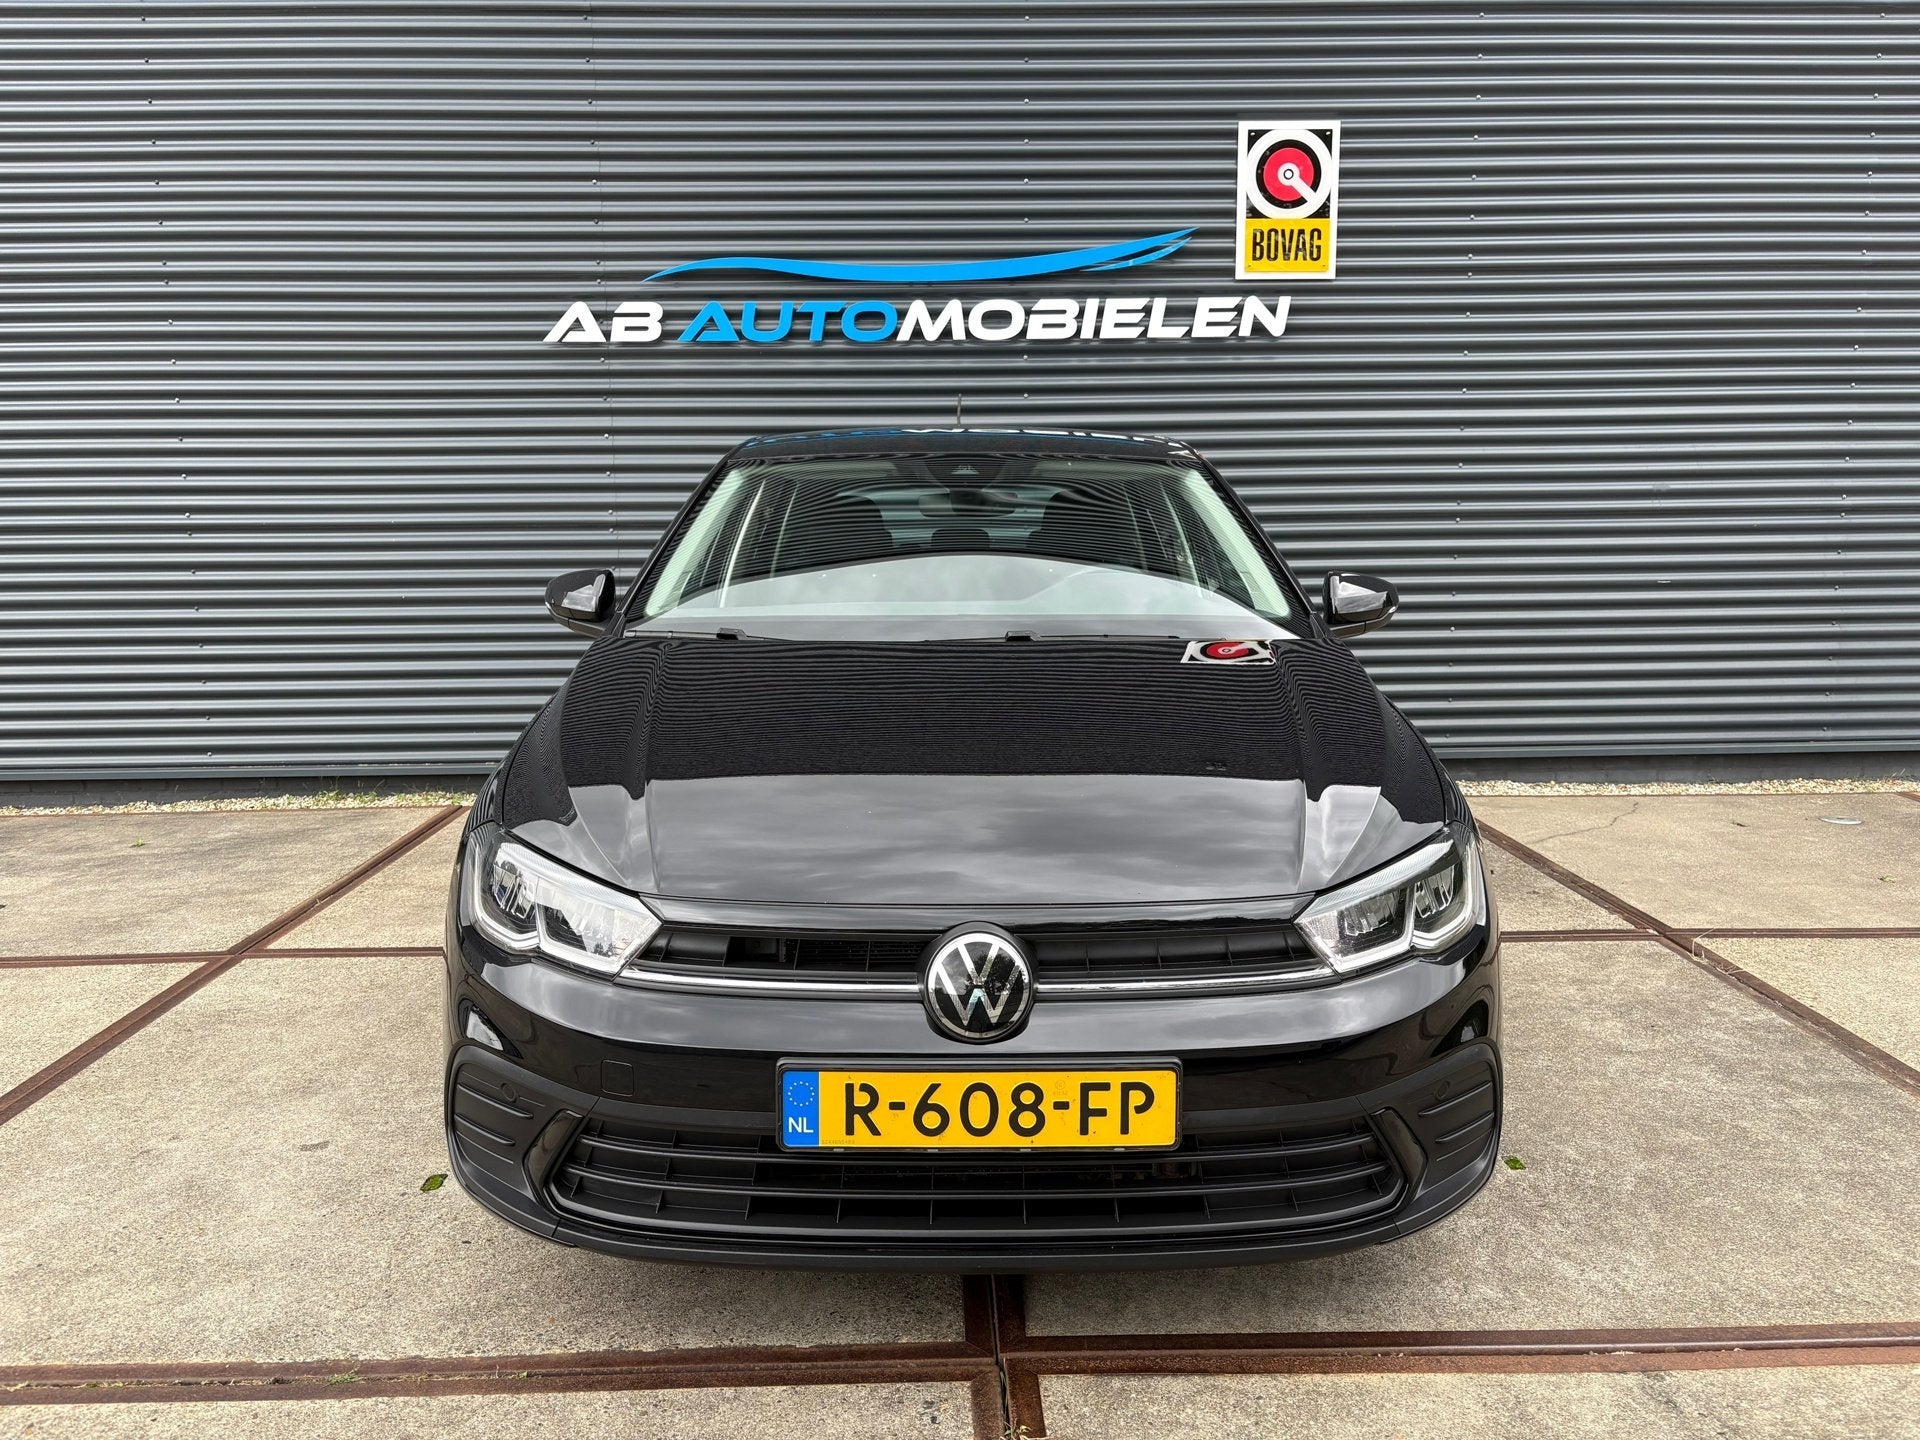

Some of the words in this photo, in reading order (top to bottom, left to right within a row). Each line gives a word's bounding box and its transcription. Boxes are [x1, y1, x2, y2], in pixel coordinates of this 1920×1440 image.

[1251, 227, 1323, 262] BOVAG
[542, 300, 664, 342] AB
[676, 295, 1292, 342] AUTOMOBIELEN
[935, 939, 1023, 1029] VW
[787, 1116, 814, 1134] NL
[843, 1081, 1156, 1138] R-608-FP
